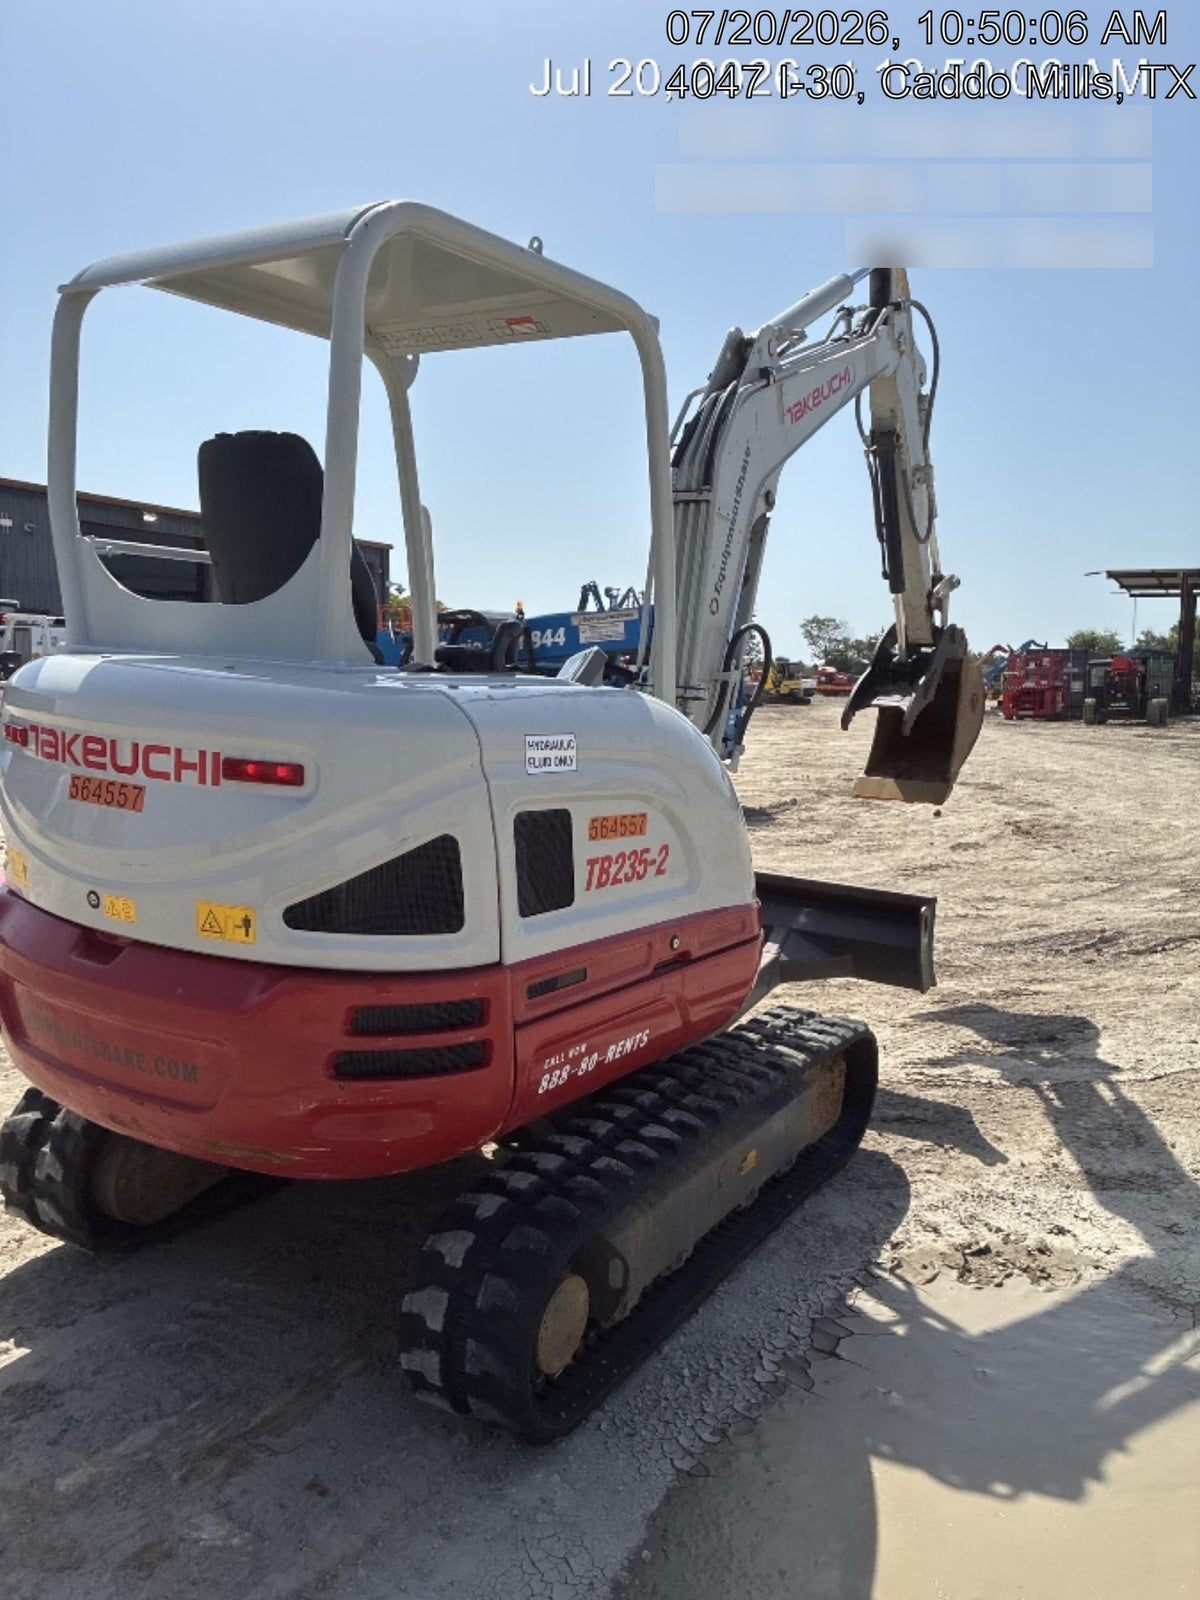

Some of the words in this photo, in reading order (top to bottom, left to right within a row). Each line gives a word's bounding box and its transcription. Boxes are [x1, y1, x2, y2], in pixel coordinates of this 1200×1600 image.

[69, 775, 145, 811] 564557
[589, 814, 647, 840] 564557
[584, 844, 669, 891] TB235-2
[538, 1028, 650, 1095] 888-80-RENTS
